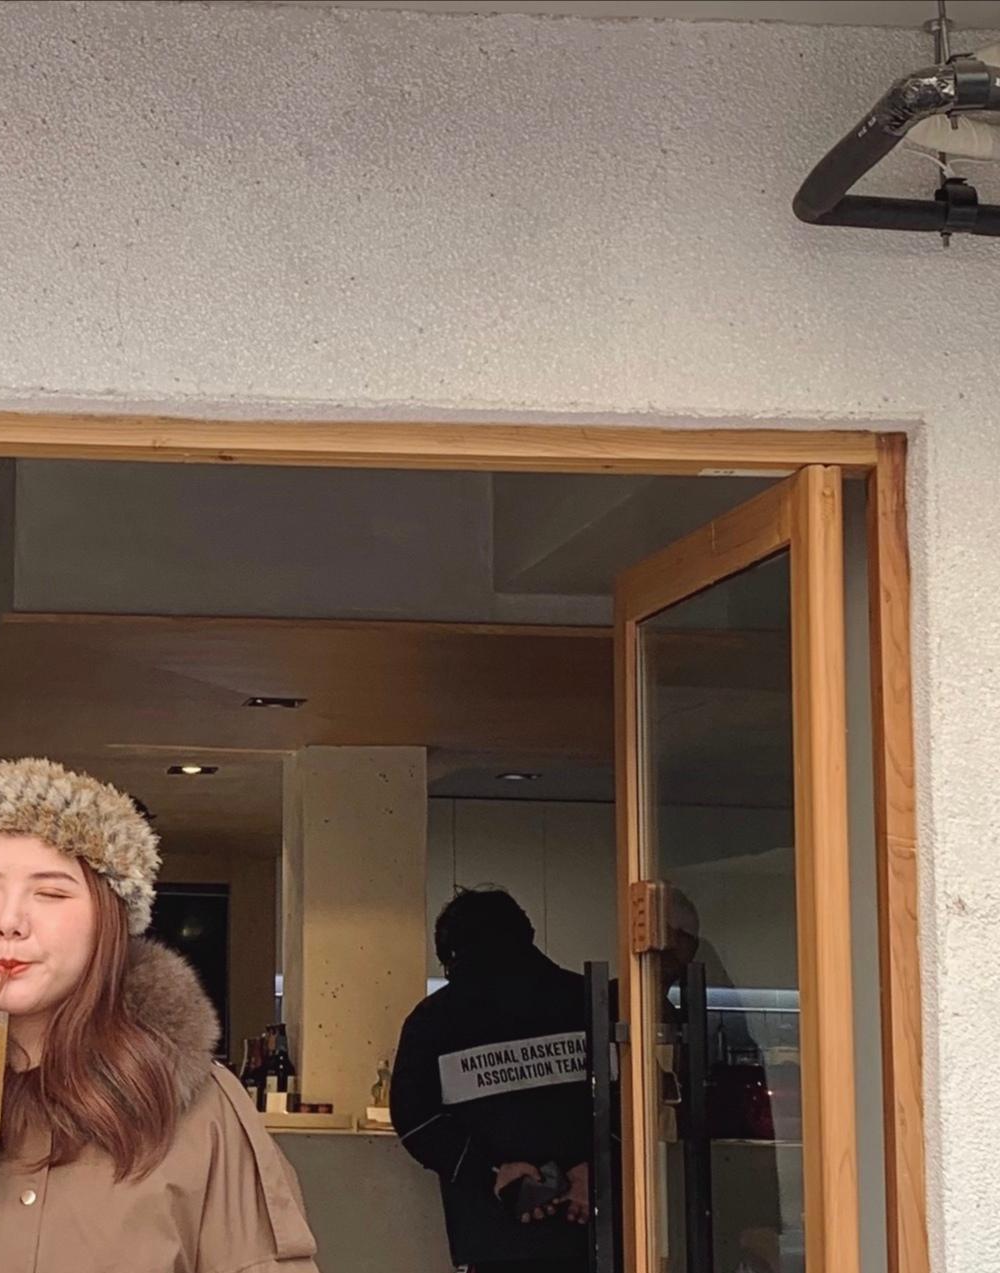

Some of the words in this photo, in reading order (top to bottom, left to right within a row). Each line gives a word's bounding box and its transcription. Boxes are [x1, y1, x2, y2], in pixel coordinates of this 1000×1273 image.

[460, 1049, 519, 1073] NATIONAL
[521, 1039, 586, 1062] BASKETBA
[477, 1062, 553, 1088] ASSOCIATION
